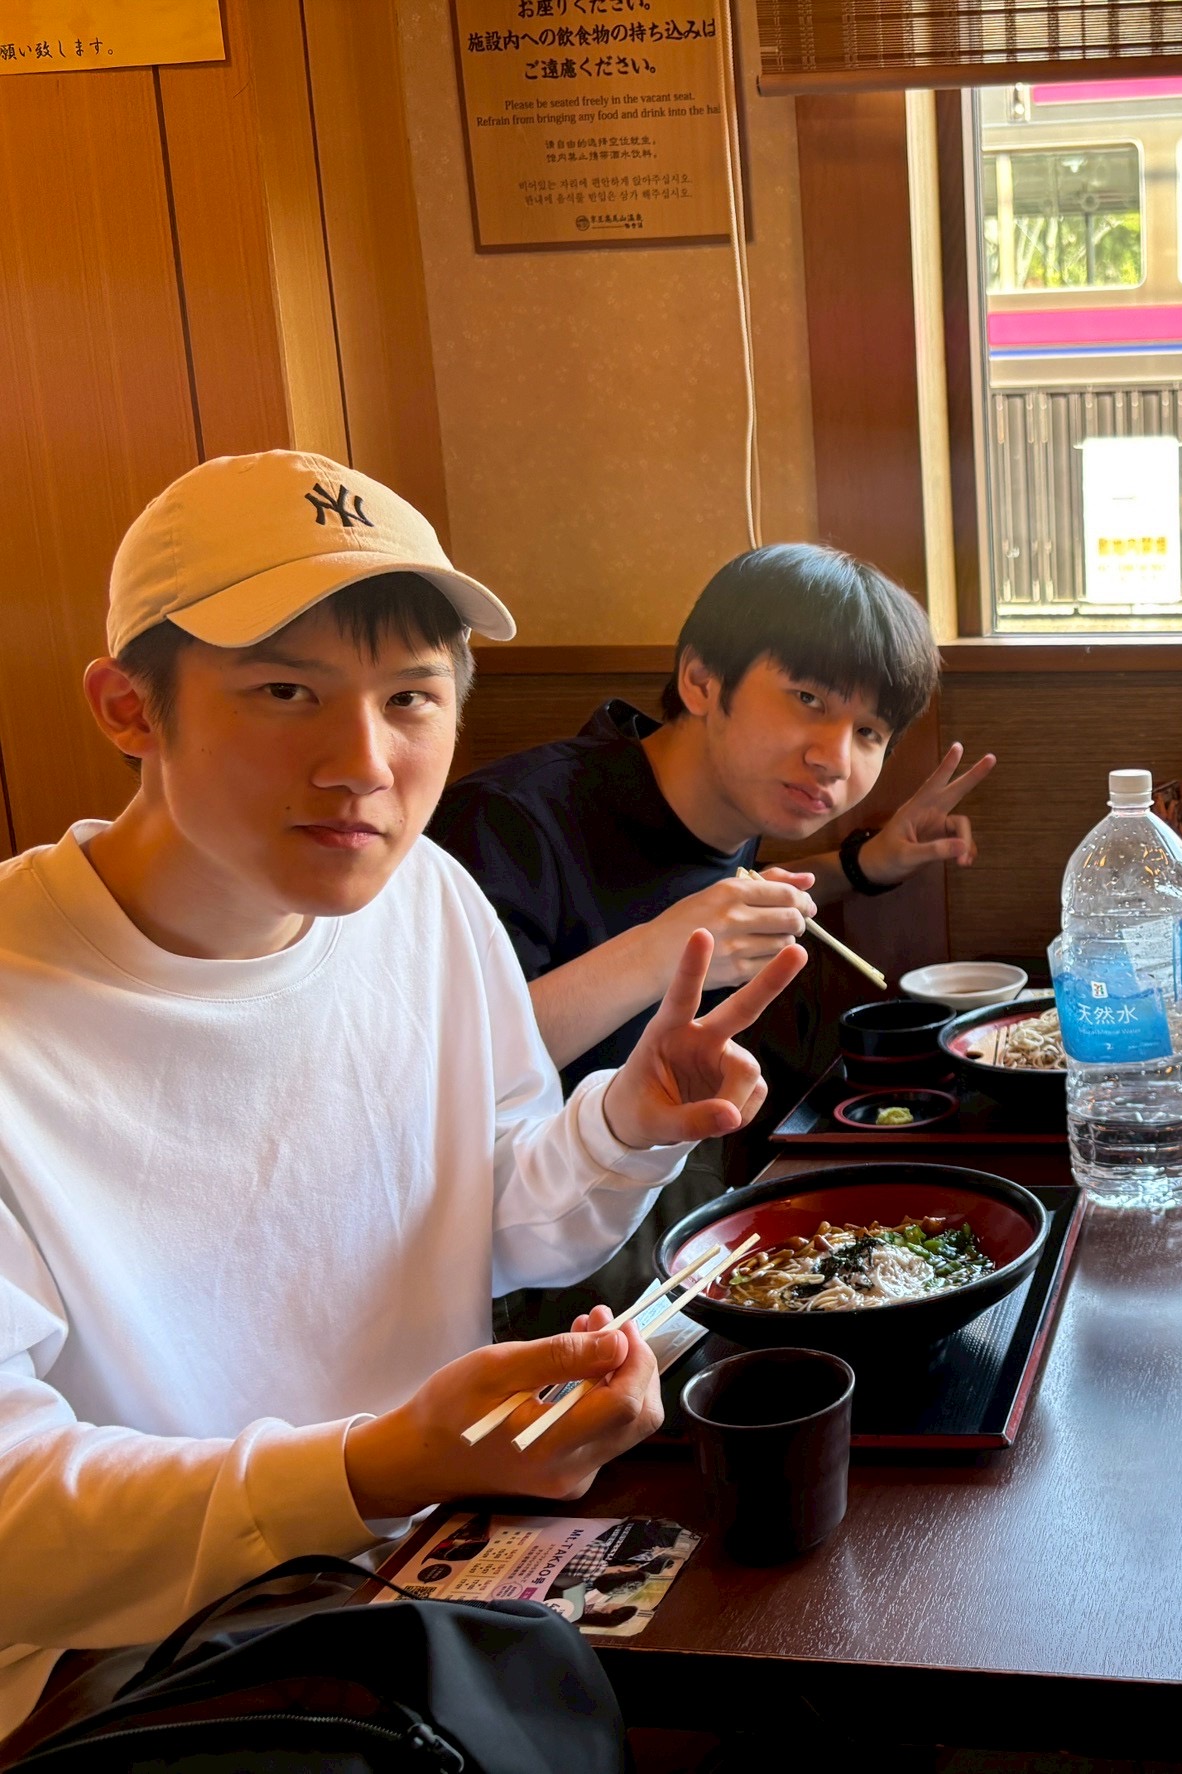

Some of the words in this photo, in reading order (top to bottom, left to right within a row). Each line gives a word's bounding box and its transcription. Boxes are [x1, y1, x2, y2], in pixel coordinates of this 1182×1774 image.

[468, 18, 716, 52] 施設内への飲食物の持ち込みは
[0, 37, 113, 60] 願い致します。
[525, 56, 656, 80] ご遠慮ください。
[505, 100, 534, 111] Please
[537, 99, 548, 109] be
[550, 97, 579, 107] seated
[582, 95, 609, 108] freely
[612, 95, 621, 105] in
[623, 94, 638, 104] the
[640, 93, 671, 103] vacant
[476, 117, 511, 127] Refrain
[512, 115, 535, 125] from
[537, 113, 576, 125] bringing
[578, 113, 595, 123] any
[598, 110, 619, 120] food
[621, 109, 638, 119] and
[641, 107, 666, 118] drink
[668, 107, 687, 117] into
[689, 105, 705, 115] the
[304, 482, 374, 527] NY
[1077, 1003, 1139, 1025] 天然水
